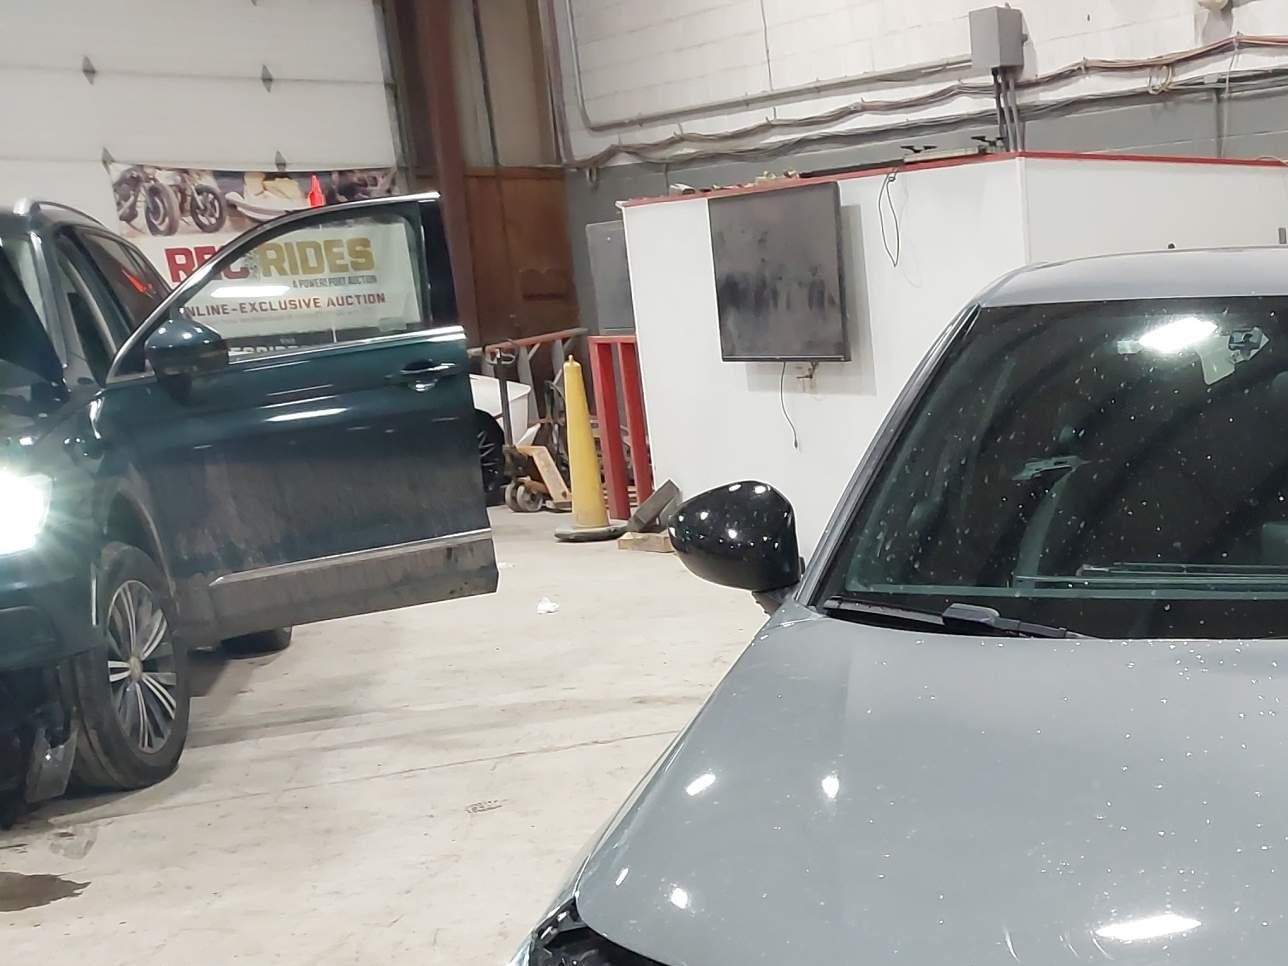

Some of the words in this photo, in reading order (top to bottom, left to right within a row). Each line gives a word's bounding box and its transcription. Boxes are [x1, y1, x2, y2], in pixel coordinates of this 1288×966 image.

[256, 238, 375, 277] RIDES
[184, 297, 321, 318] NLINE-EXCLUSIVE
[327, 293, 385, 307] AUCTION
